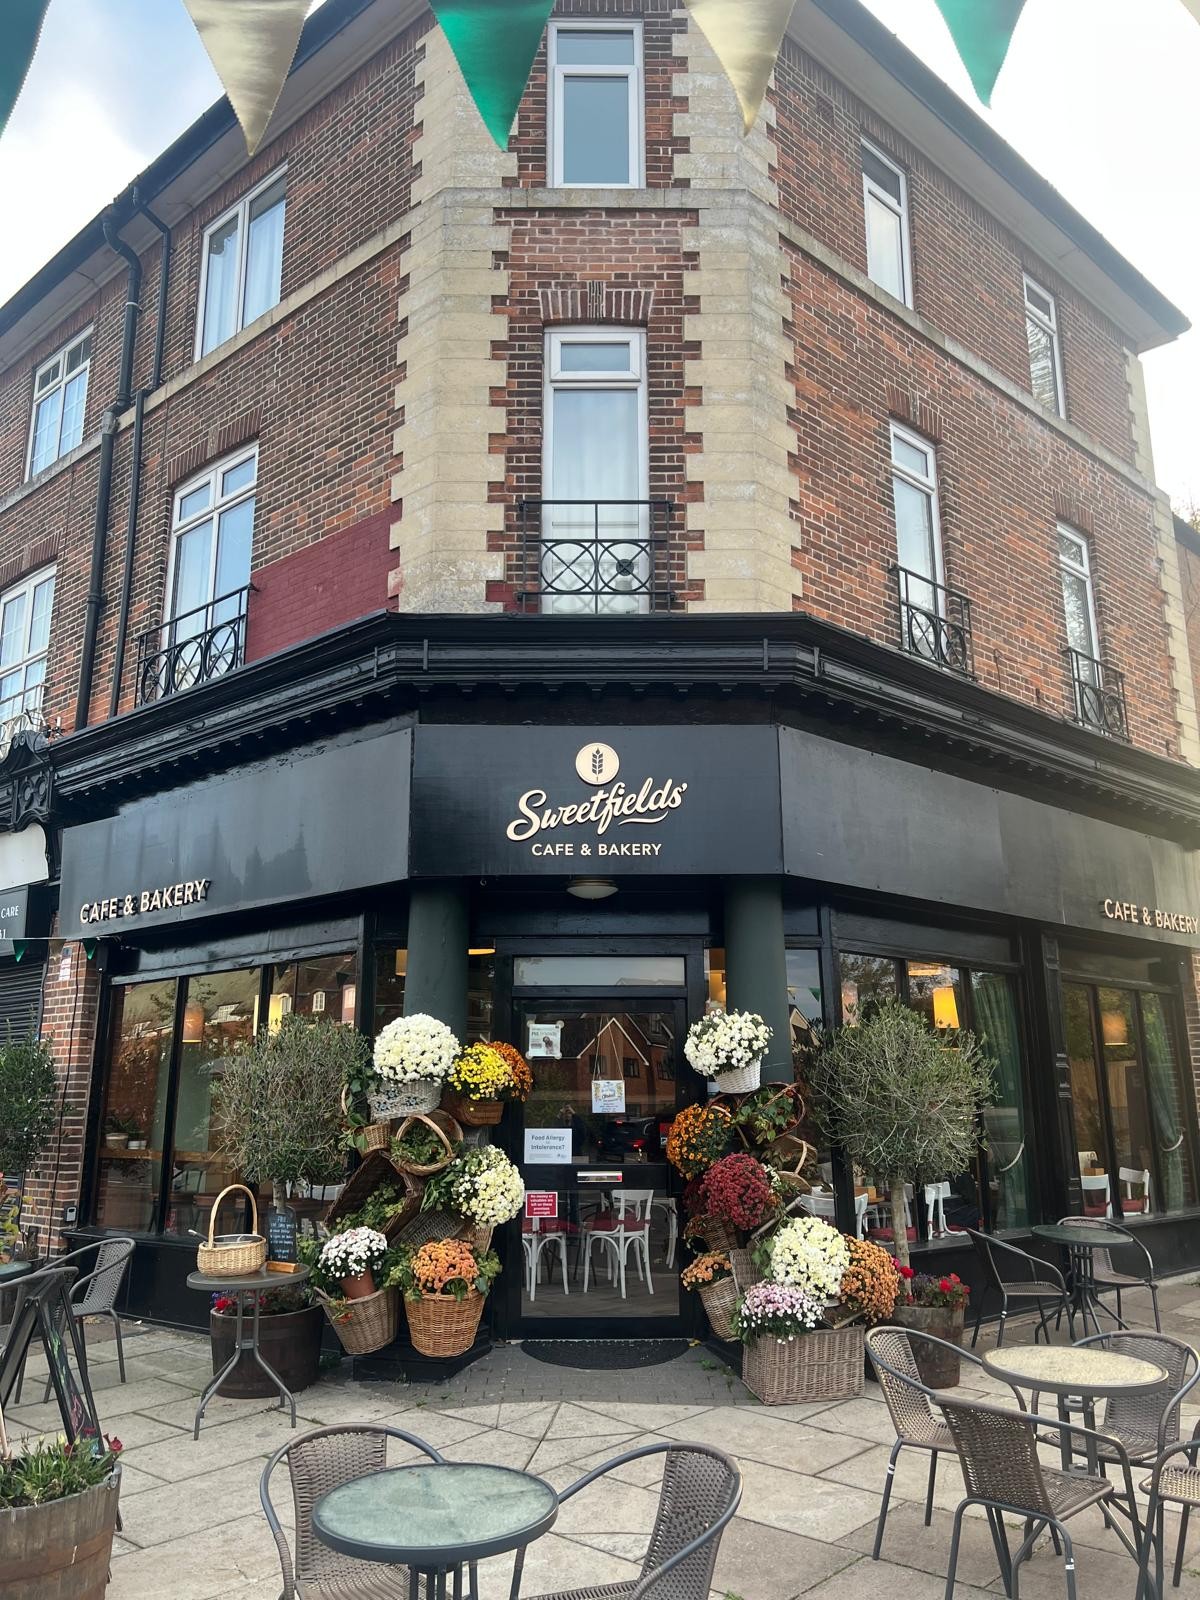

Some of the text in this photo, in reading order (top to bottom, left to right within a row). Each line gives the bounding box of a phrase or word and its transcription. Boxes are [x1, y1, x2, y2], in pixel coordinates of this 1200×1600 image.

[531, 843, 662, 856] CAFE & BAKERY
[1, 905, 19, 919] CARE
[80, 878, 206, 924] CAFE & BAKERY
[1104, 898, 1199, 934] CAFE & BAKERY
